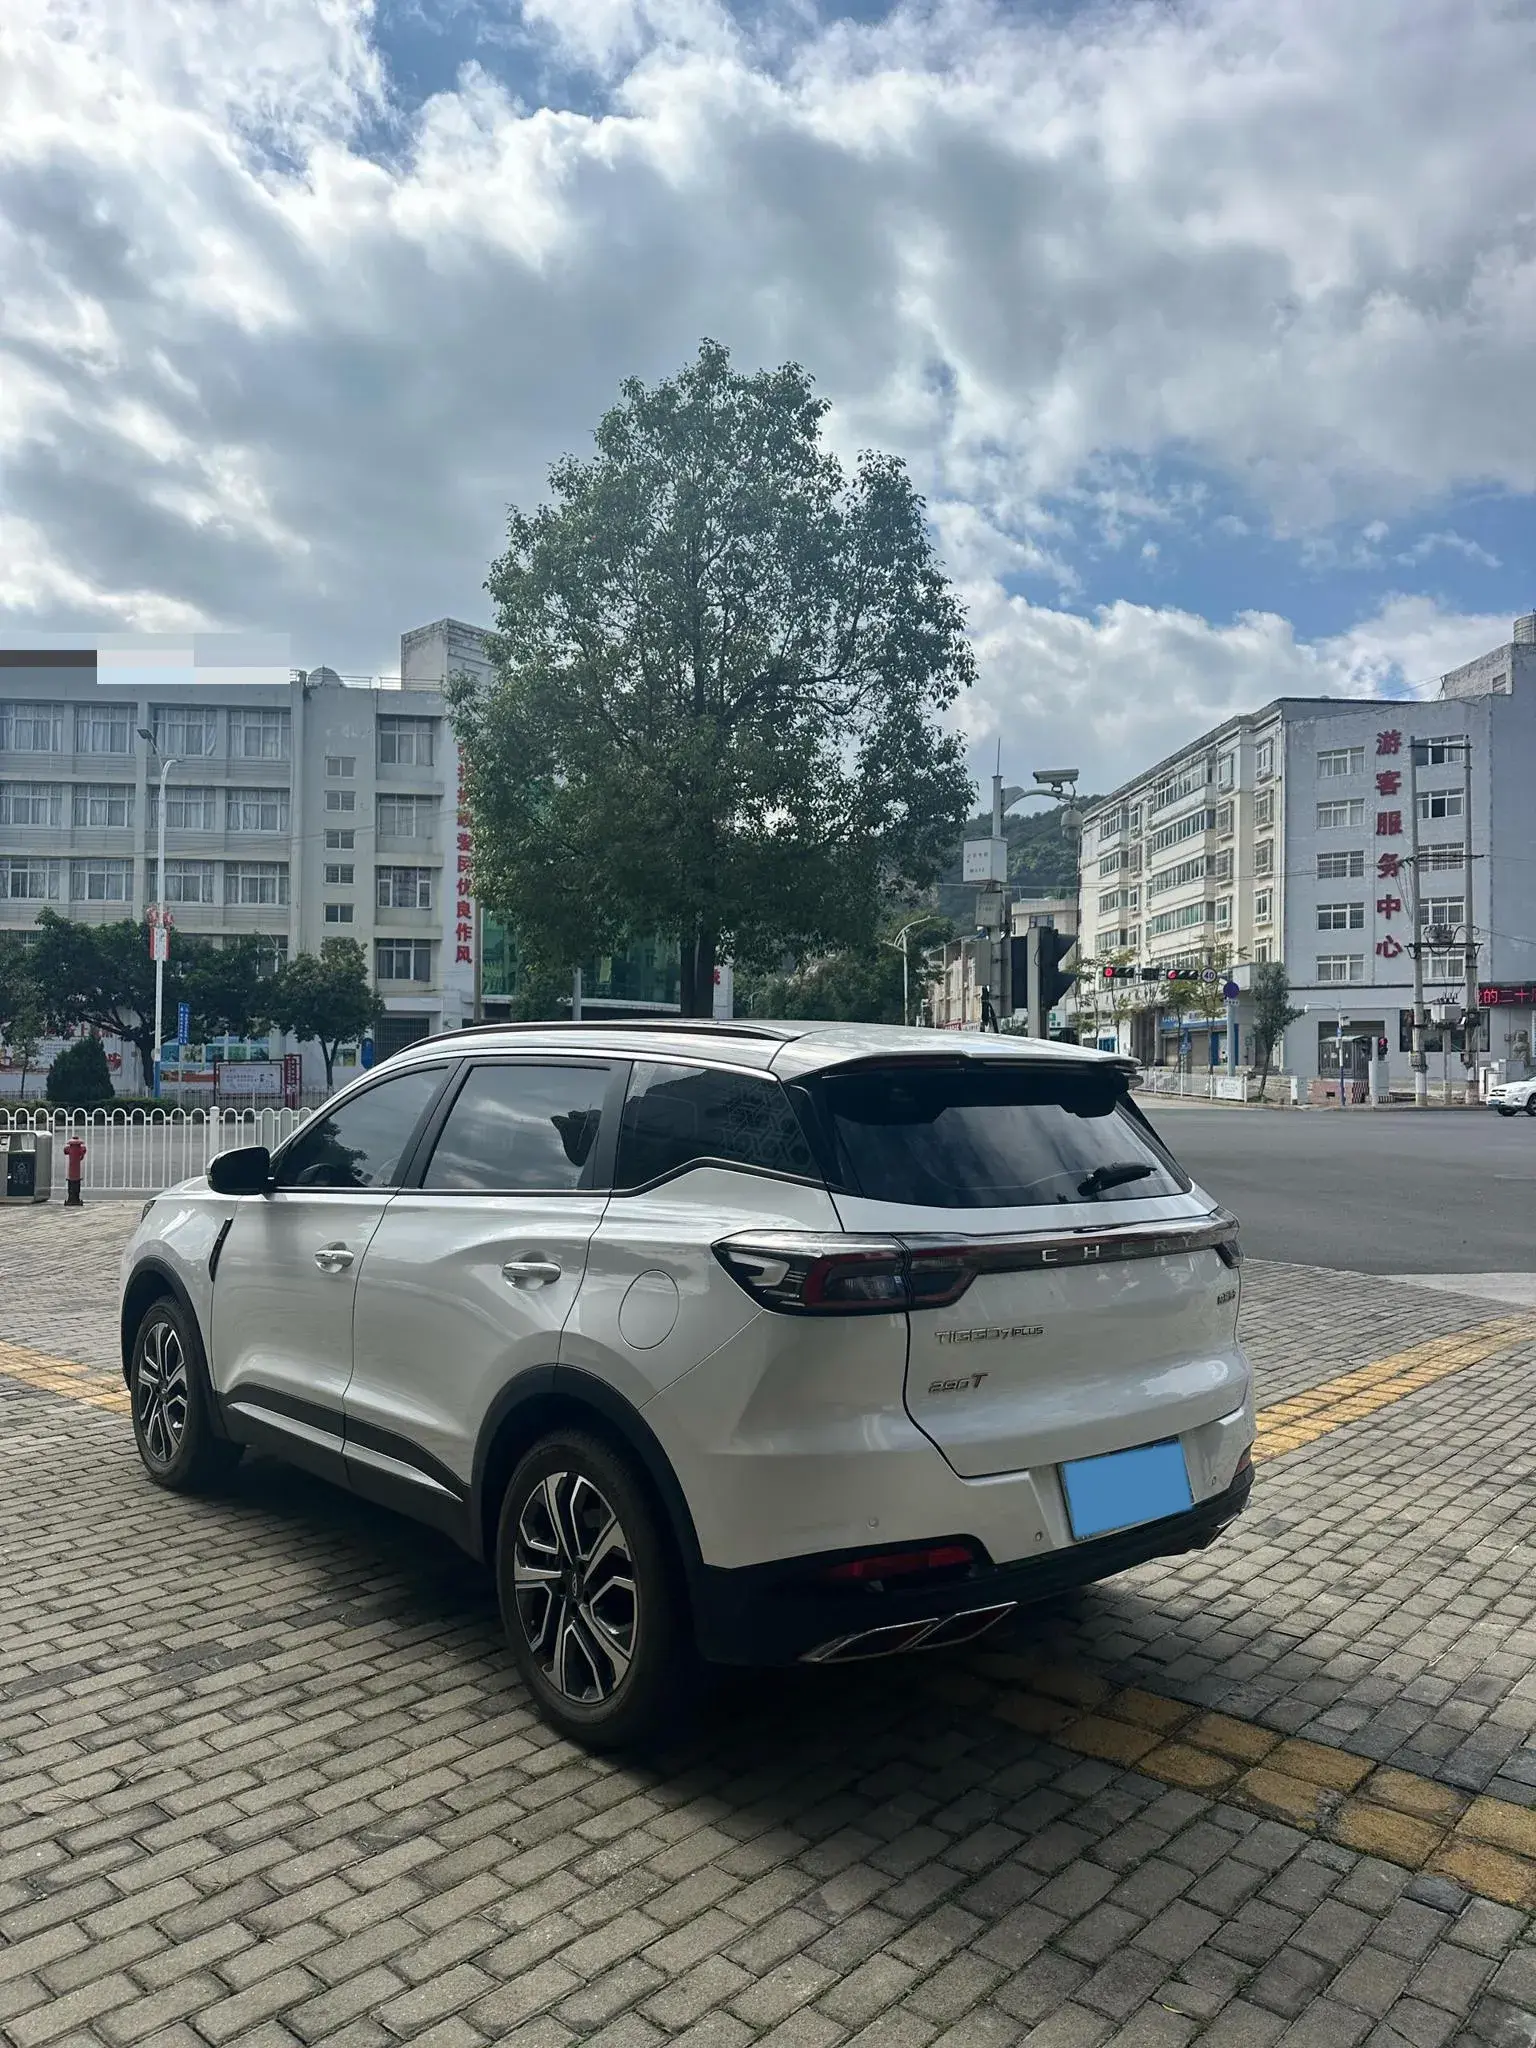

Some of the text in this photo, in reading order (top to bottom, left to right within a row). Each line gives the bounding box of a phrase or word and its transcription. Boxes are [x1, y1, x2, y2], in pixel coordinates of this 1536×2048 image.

[1375, 729, 1403, 959] 游客服务中心
[1203, 969, 1215, 980] 40
[1478, 986, 1536, 1004] 的二十
[1041, 1234, 1193, 1263] CHERY
